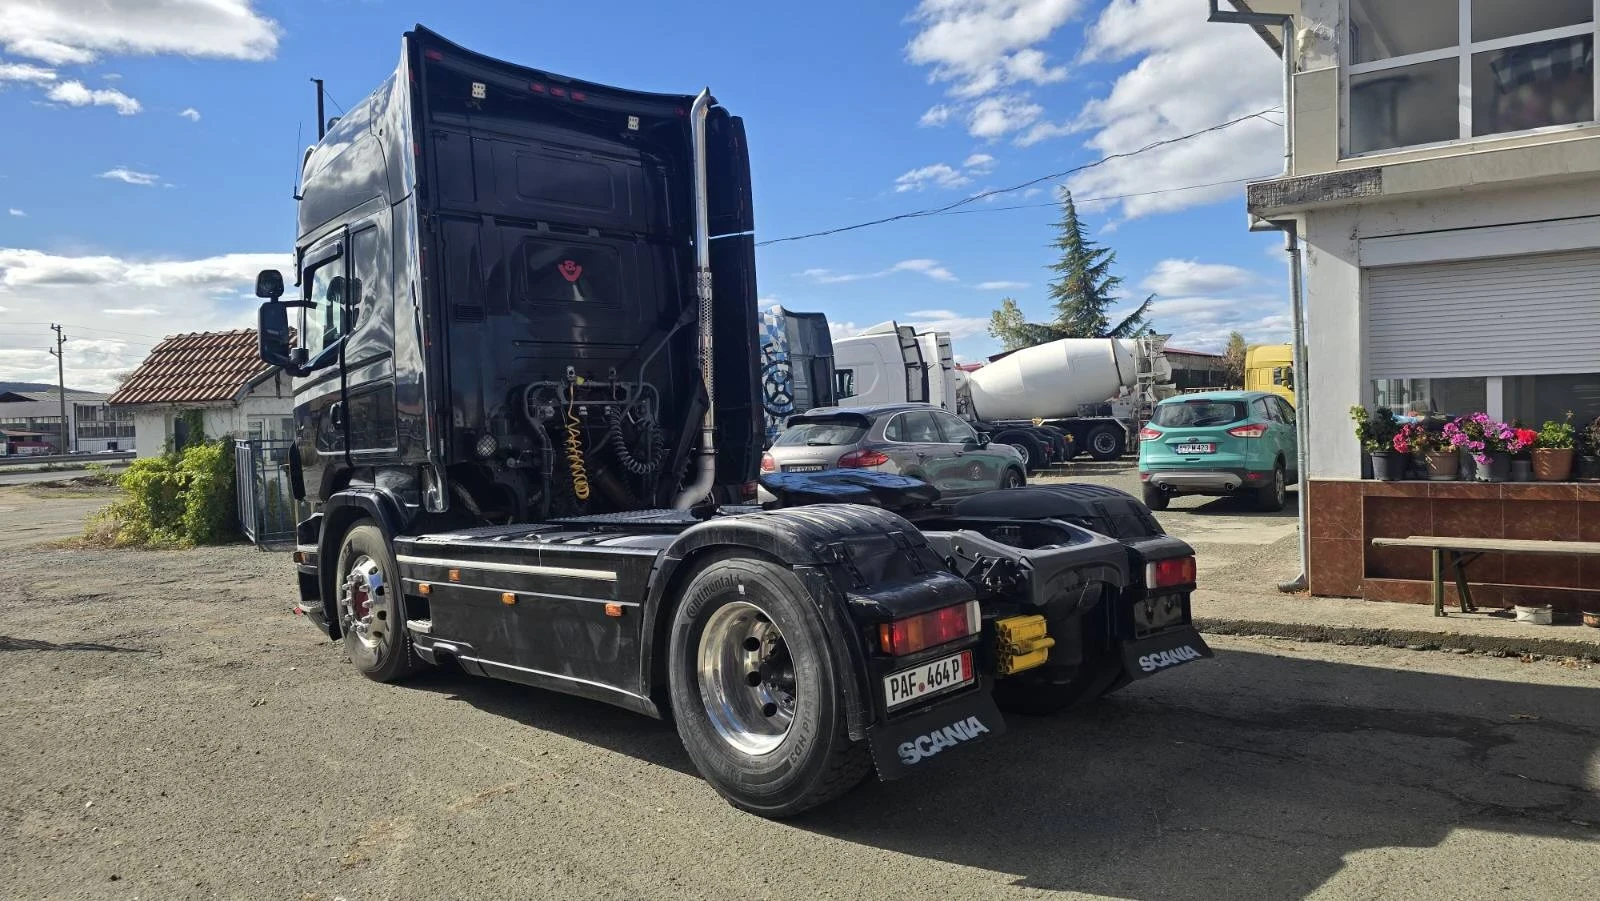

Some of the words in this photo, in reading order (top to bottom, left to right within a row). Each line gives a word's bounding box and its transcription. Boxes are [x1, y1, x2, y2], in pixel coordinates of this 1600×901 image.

[686, 574, 735, 619] Continental
[1139, 645, 1202, 672] SCANIA
[890, 671, 917, 701] PAF
[897, 715, 990, 765] SCANIA
